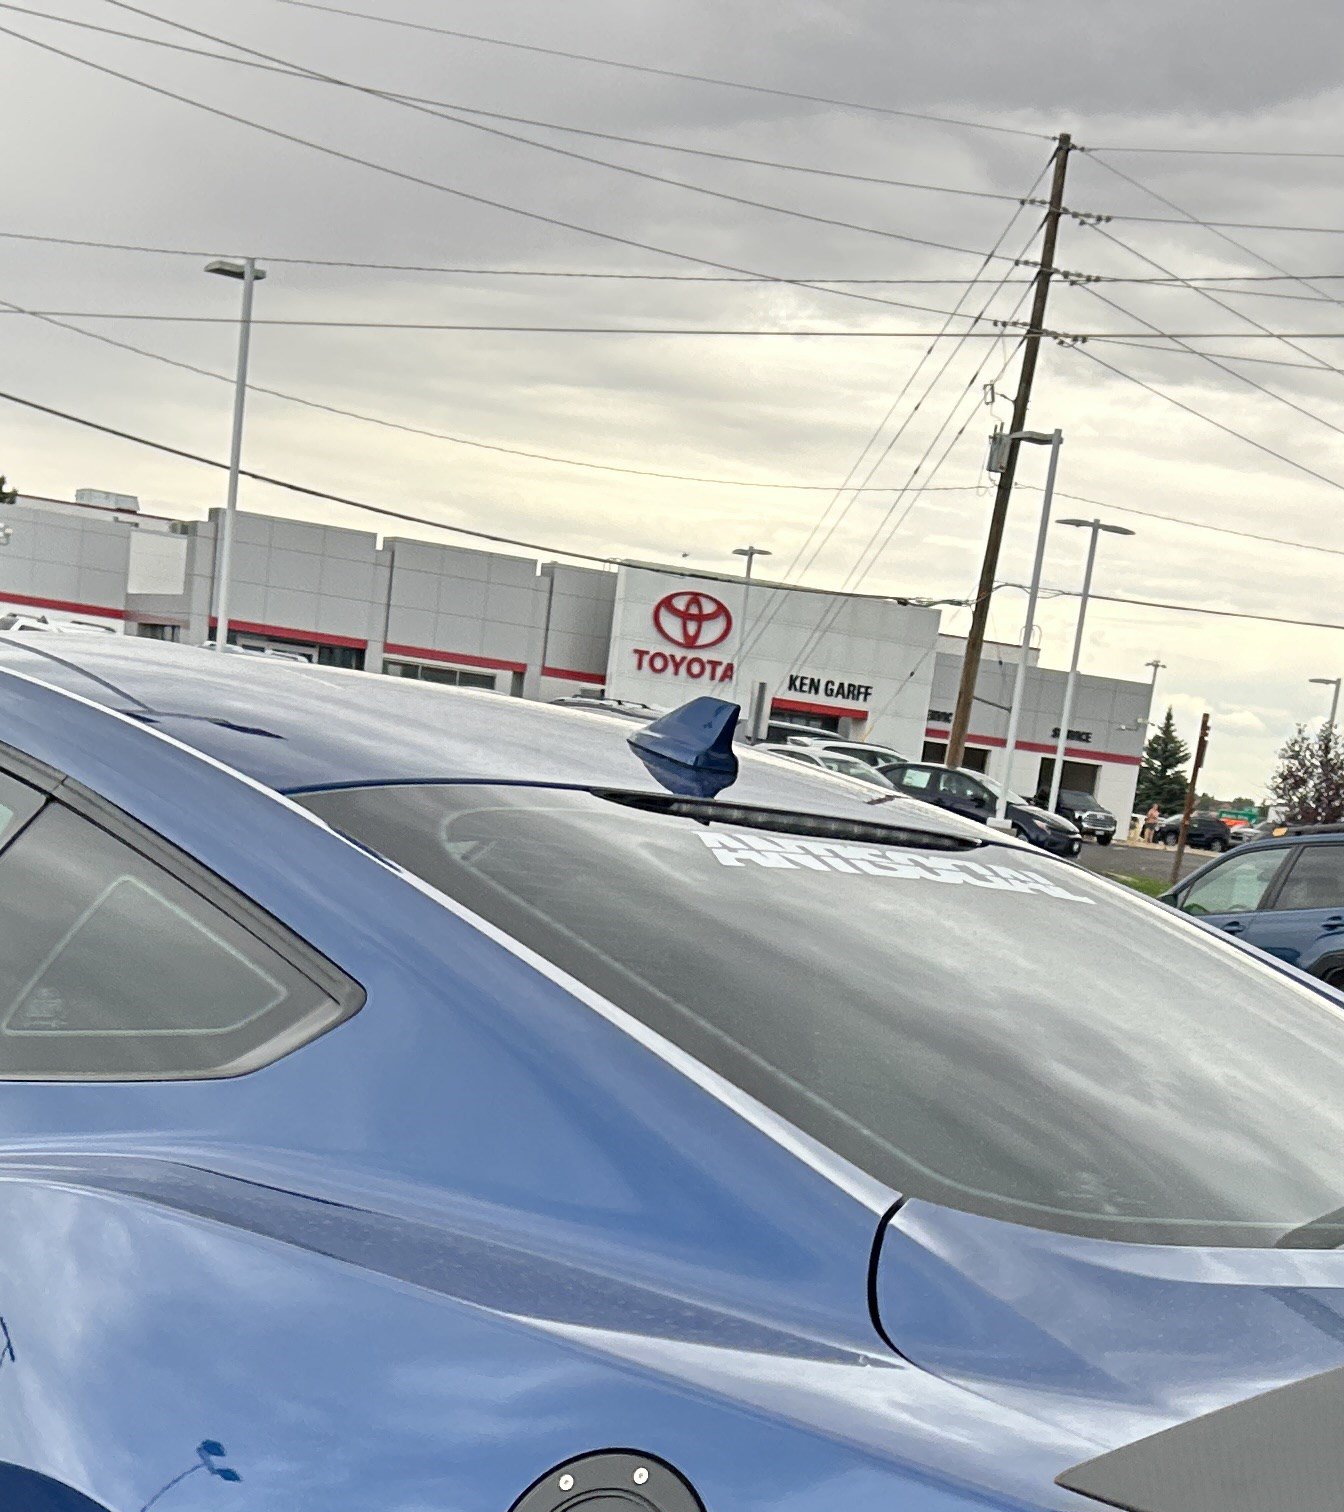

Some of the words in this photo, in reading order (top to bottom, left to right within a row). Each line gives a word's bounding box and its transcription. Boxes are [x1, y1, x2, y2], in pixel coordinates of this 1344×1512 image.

[633, 648, 735, 682] TOYOTA
[787, 673, 821, 696] KEN
[824, 679, 873, 703] GARFF
